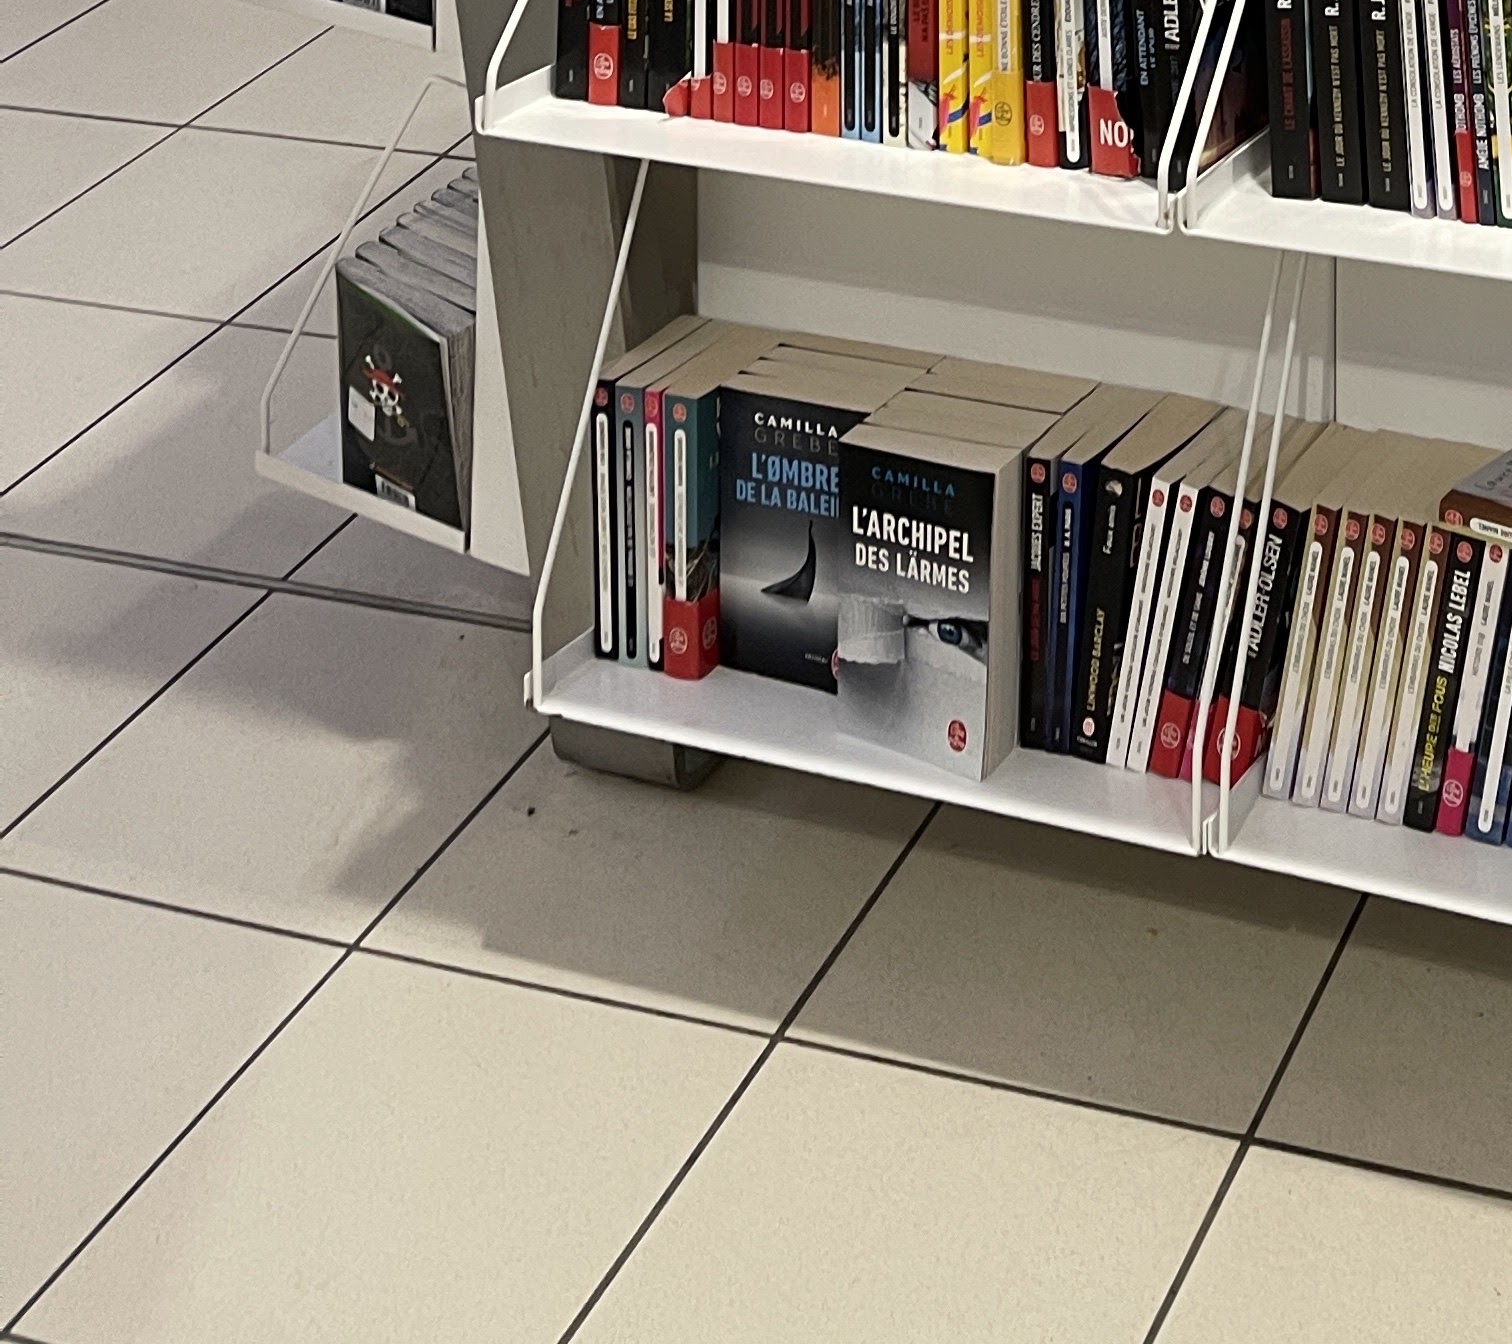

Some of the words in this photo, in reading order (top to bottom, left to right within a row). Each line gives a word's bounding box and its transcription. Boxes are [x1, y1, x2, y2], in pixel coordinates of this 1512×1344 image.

[753, 427, 839, 457] GREBE
[754, 412, 838, 438] CAMILLA
[735, 479, 756, 500] DE
[761, 484, 781, 506] LA
[871, 466, 956, 497] CAMILLA
[852, 504, 974, 563] L'ARCHIPEL
[855, 542, 890, 574] DES
[896, 550, 969, 594] LÄRMES
[1448, 568, 1471, 611] LEBEL
[1438, 614, 1463, 673] NICOLAS
